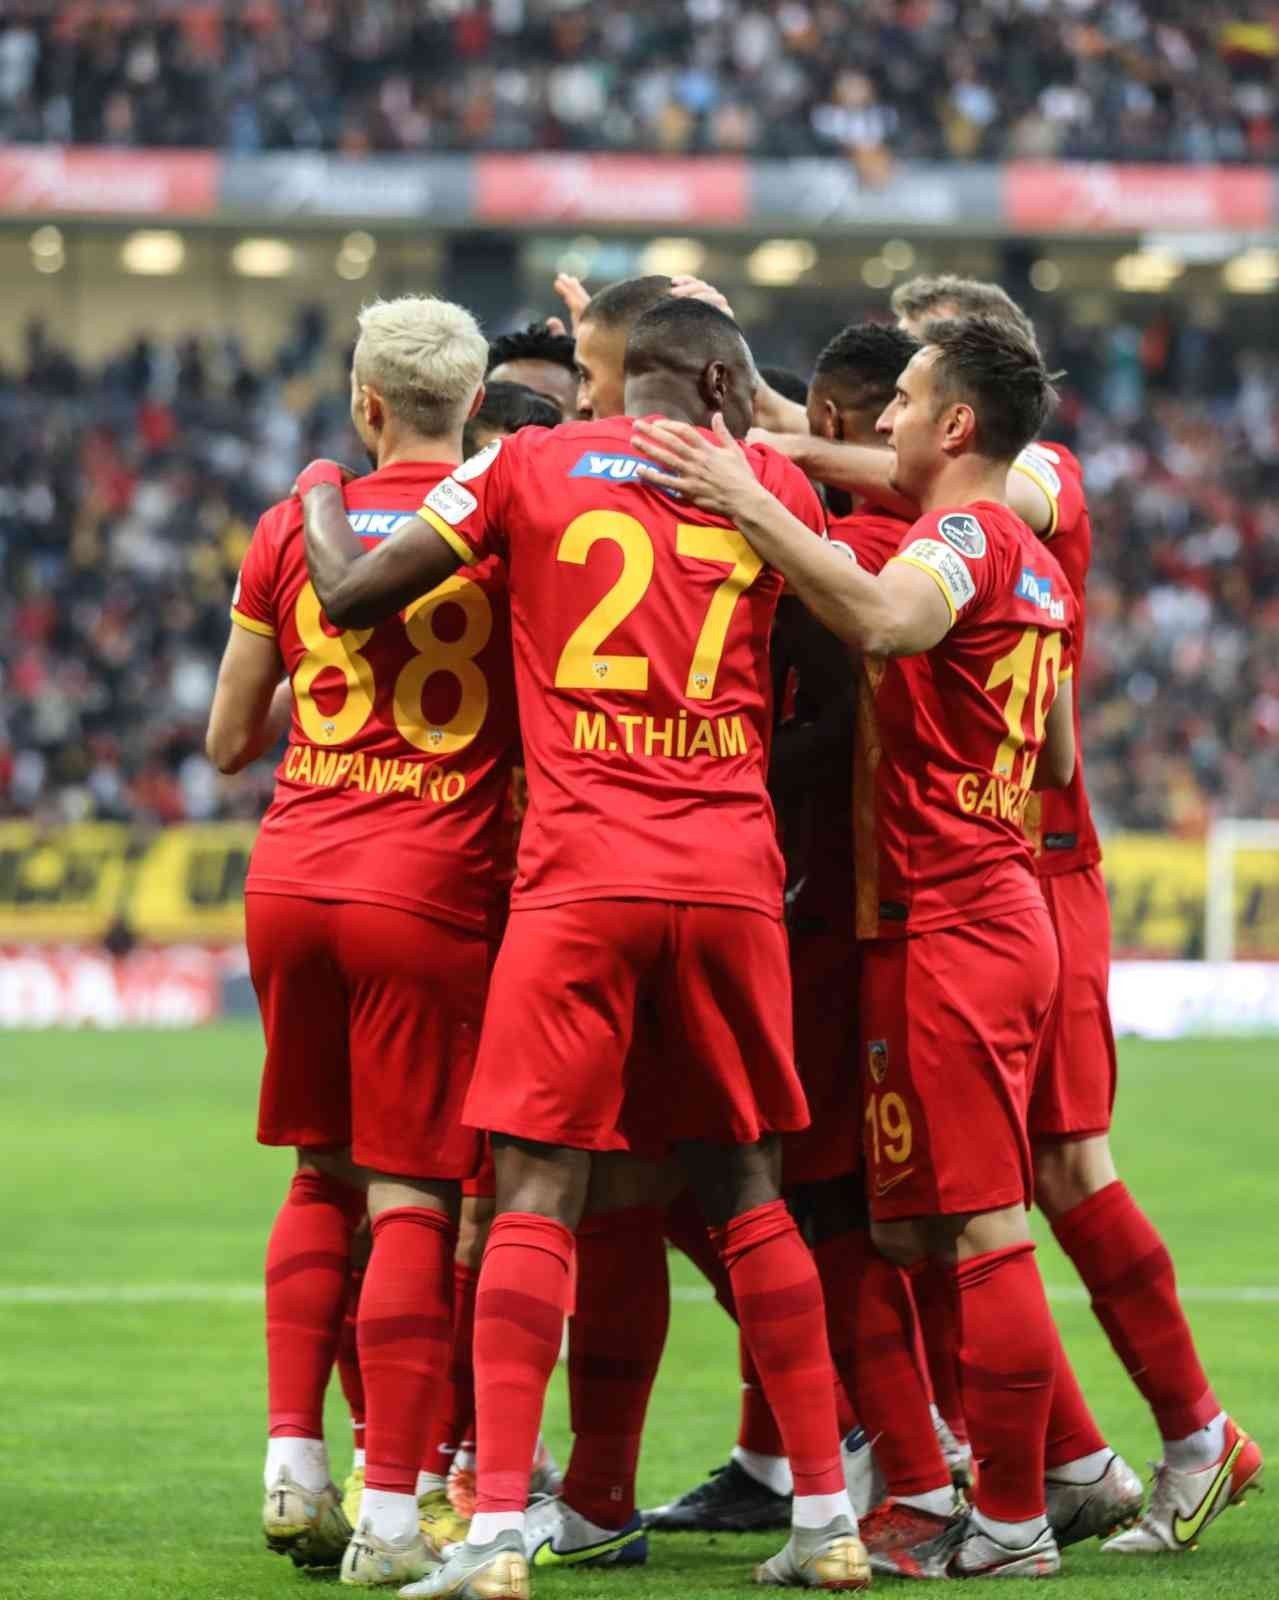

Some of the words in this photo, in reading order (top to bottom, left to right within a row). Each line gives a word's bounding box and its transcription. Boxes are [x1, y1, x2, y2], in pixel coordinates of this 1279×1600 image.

[293, 575, 492, 754] 88
[554, 509, 764, 700] 27
[284, 745, 466, 803] CAMPANHARO
[865, 1092, 913, 1164] 19
